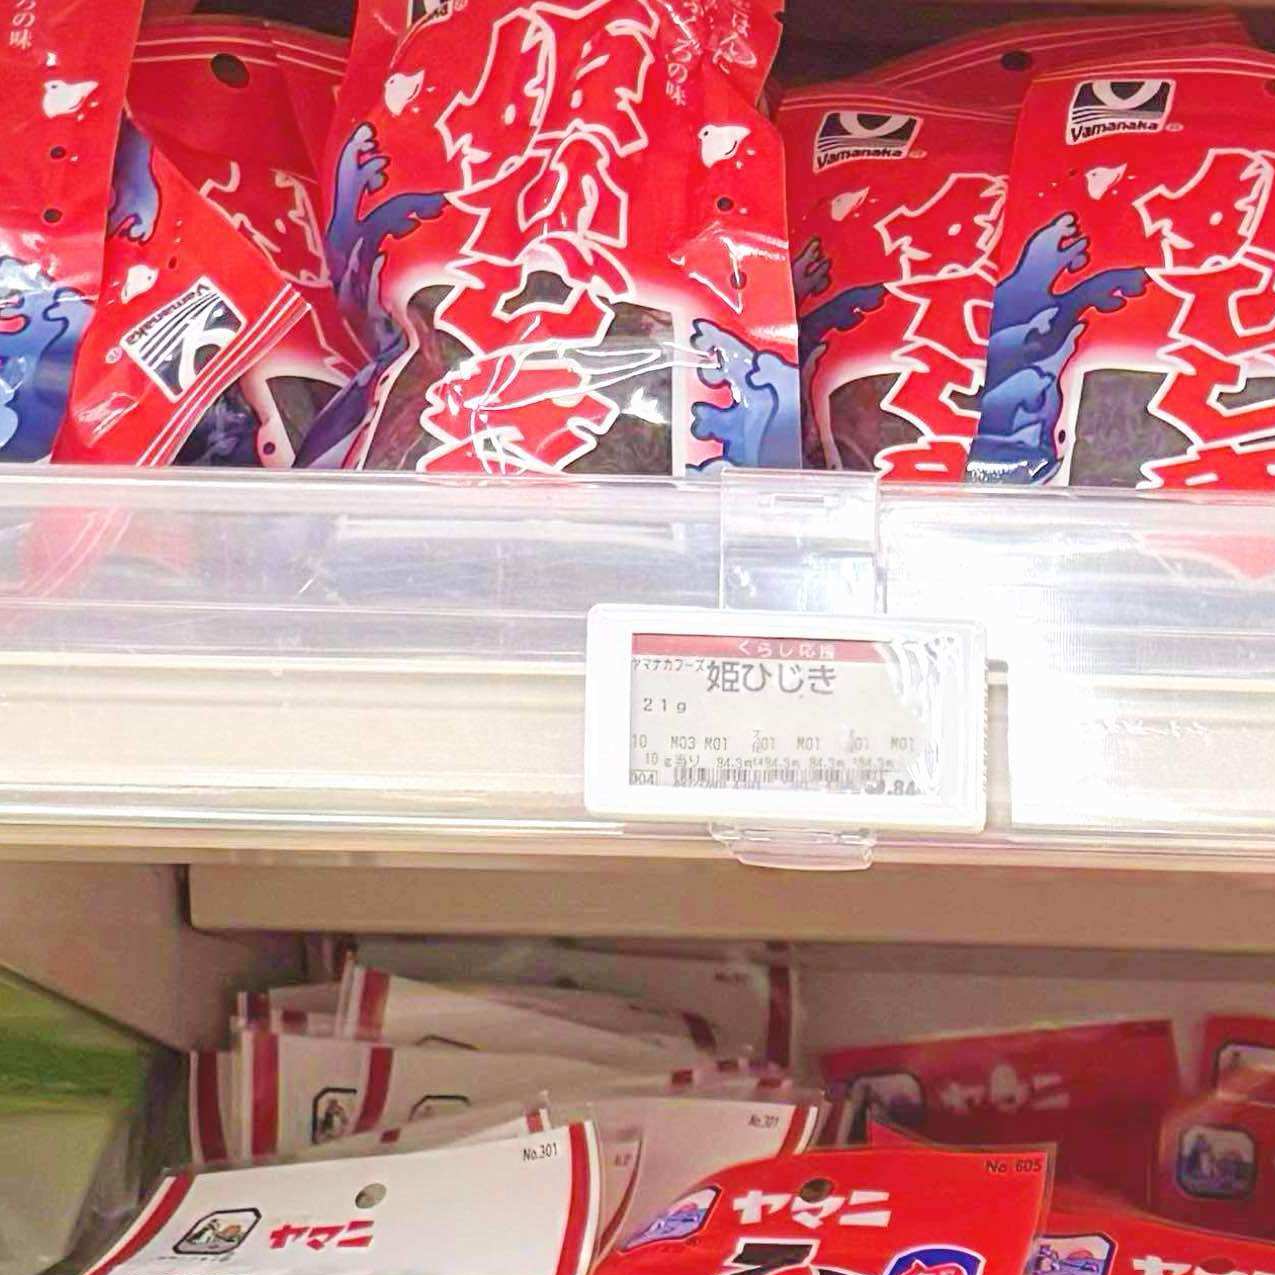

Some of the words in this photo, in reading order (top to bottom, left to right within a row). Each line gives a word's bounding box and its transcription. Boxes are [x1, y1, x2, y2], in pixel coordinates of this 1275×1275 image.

[1070, 117, 1160, 142] Yamanaka
[707, 660, 838, 696] 姫ひじき
[522, 1142, 559, 1161] No.301
[733, 1188, 891, 1229] ヤマニ
[269, 1220, 375, 1252] ヤマニ
